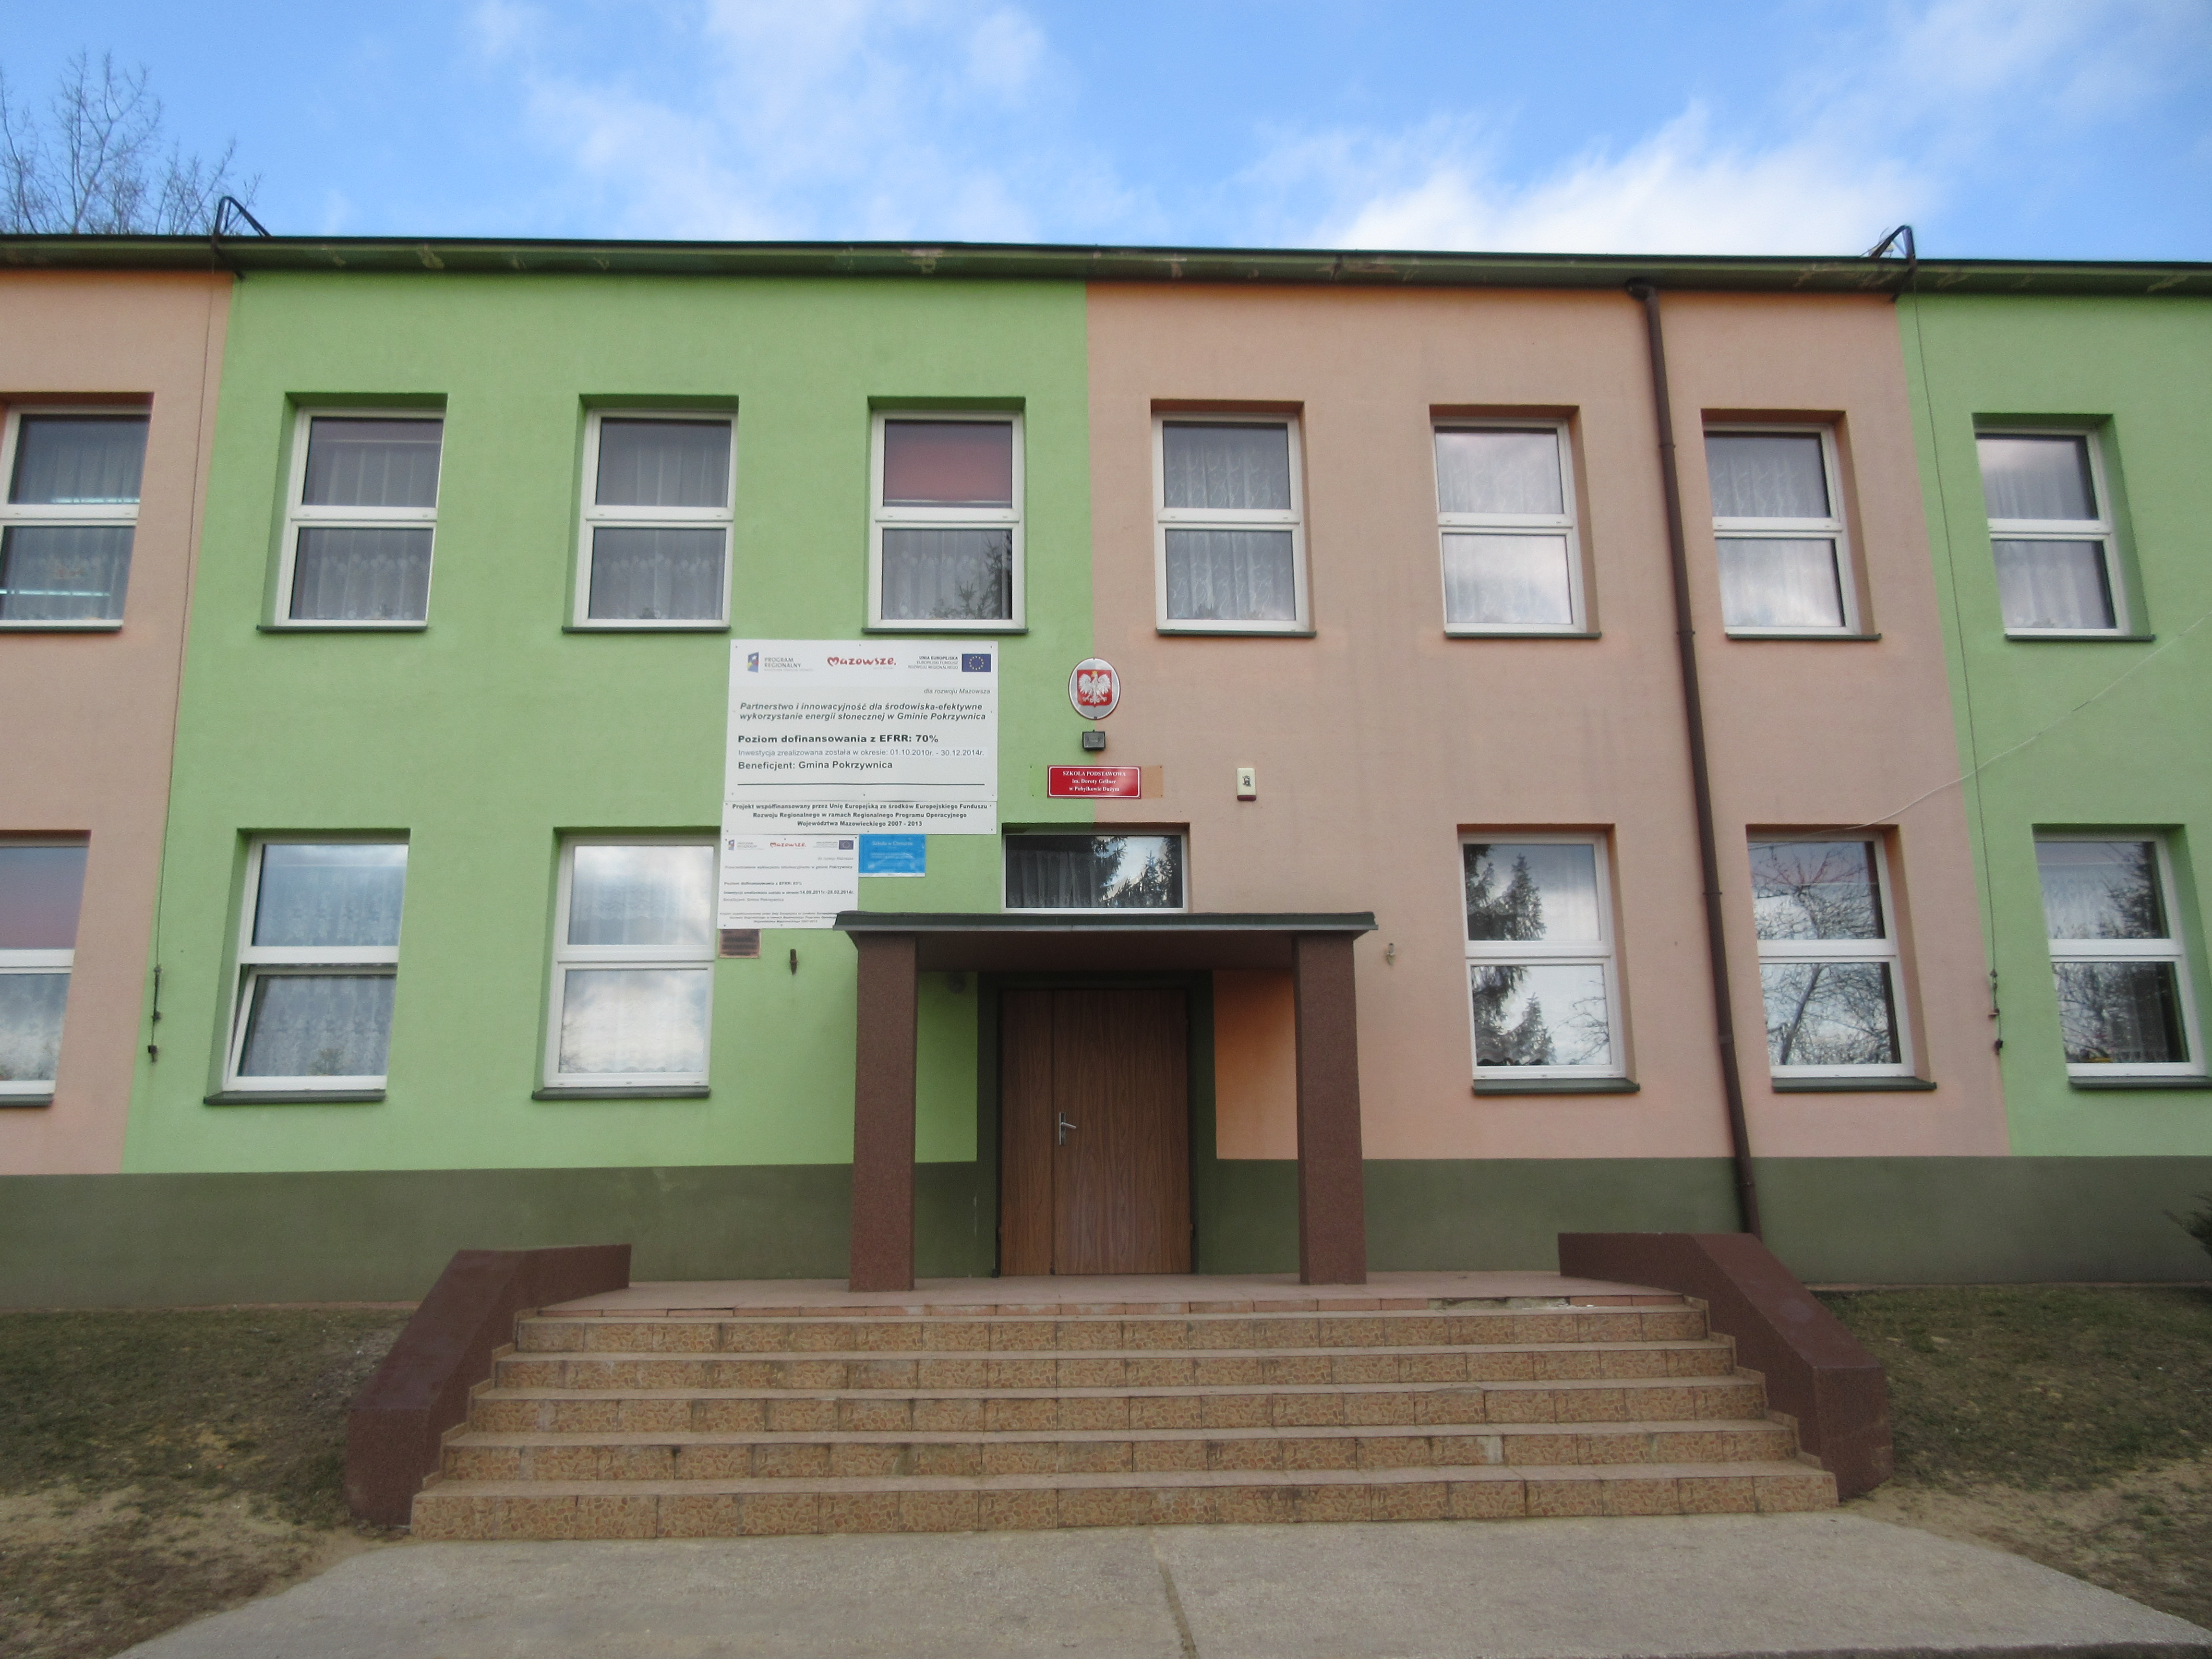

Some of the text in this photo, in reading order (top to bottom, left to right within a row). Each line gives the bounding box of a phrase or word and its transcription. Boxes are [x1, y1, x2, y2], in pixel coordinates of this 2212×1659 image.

[801, 703, 866, 712] innowacyjność
[885, 703, 983, 712] środowiska-efektywne
[740, 712, 803, 721] wykorzystanie
[805, 712, 836, 721] energii
[838, 712, 885, 721] słonecznej
[930, 712, 986, 722] Pokrzywnica
[915, 734, 938, 743] 70%
[738, 760, 893, 771] Beneficjent: Gmina Pokrzywnica
